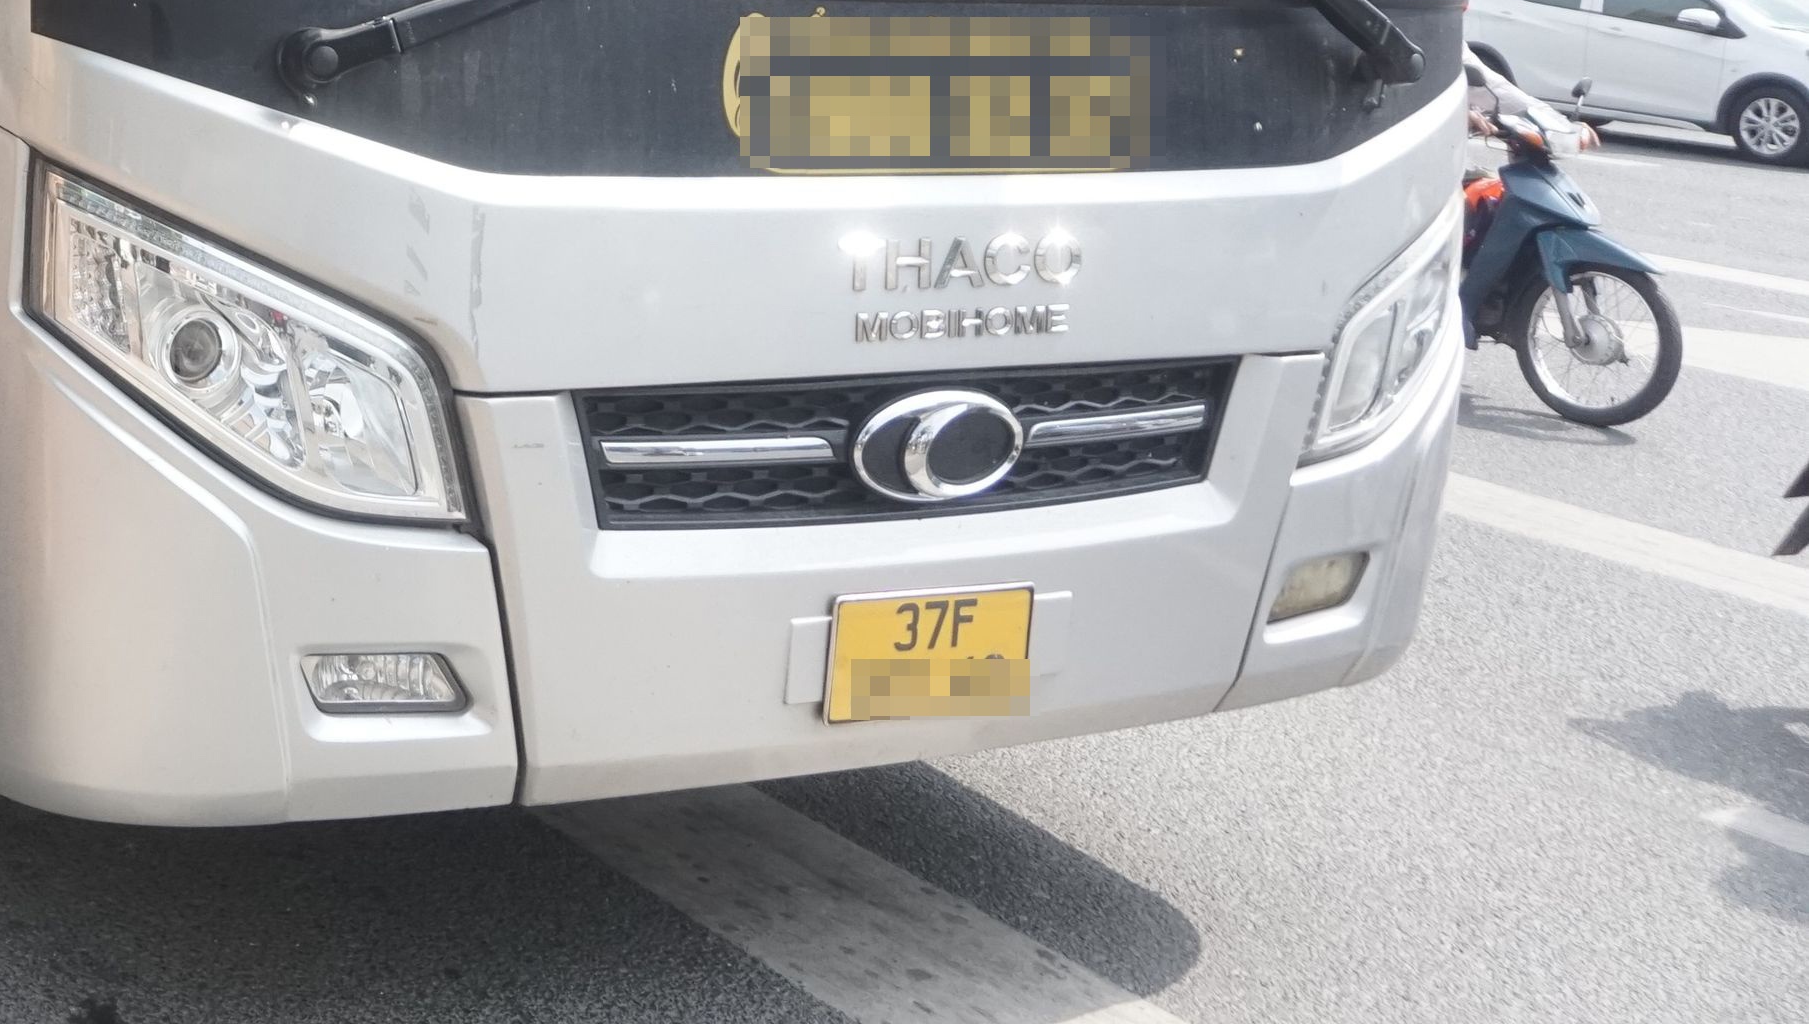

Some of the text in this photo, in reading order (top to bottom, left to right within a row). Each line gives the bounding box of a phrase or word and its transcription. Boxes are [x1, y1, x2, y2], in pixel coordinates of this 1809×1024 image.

[840, 229, 1085, 292] THACO
[854, 303, 1071, 343] MOBIHOME
[893, 598, 979, 653] 37F
